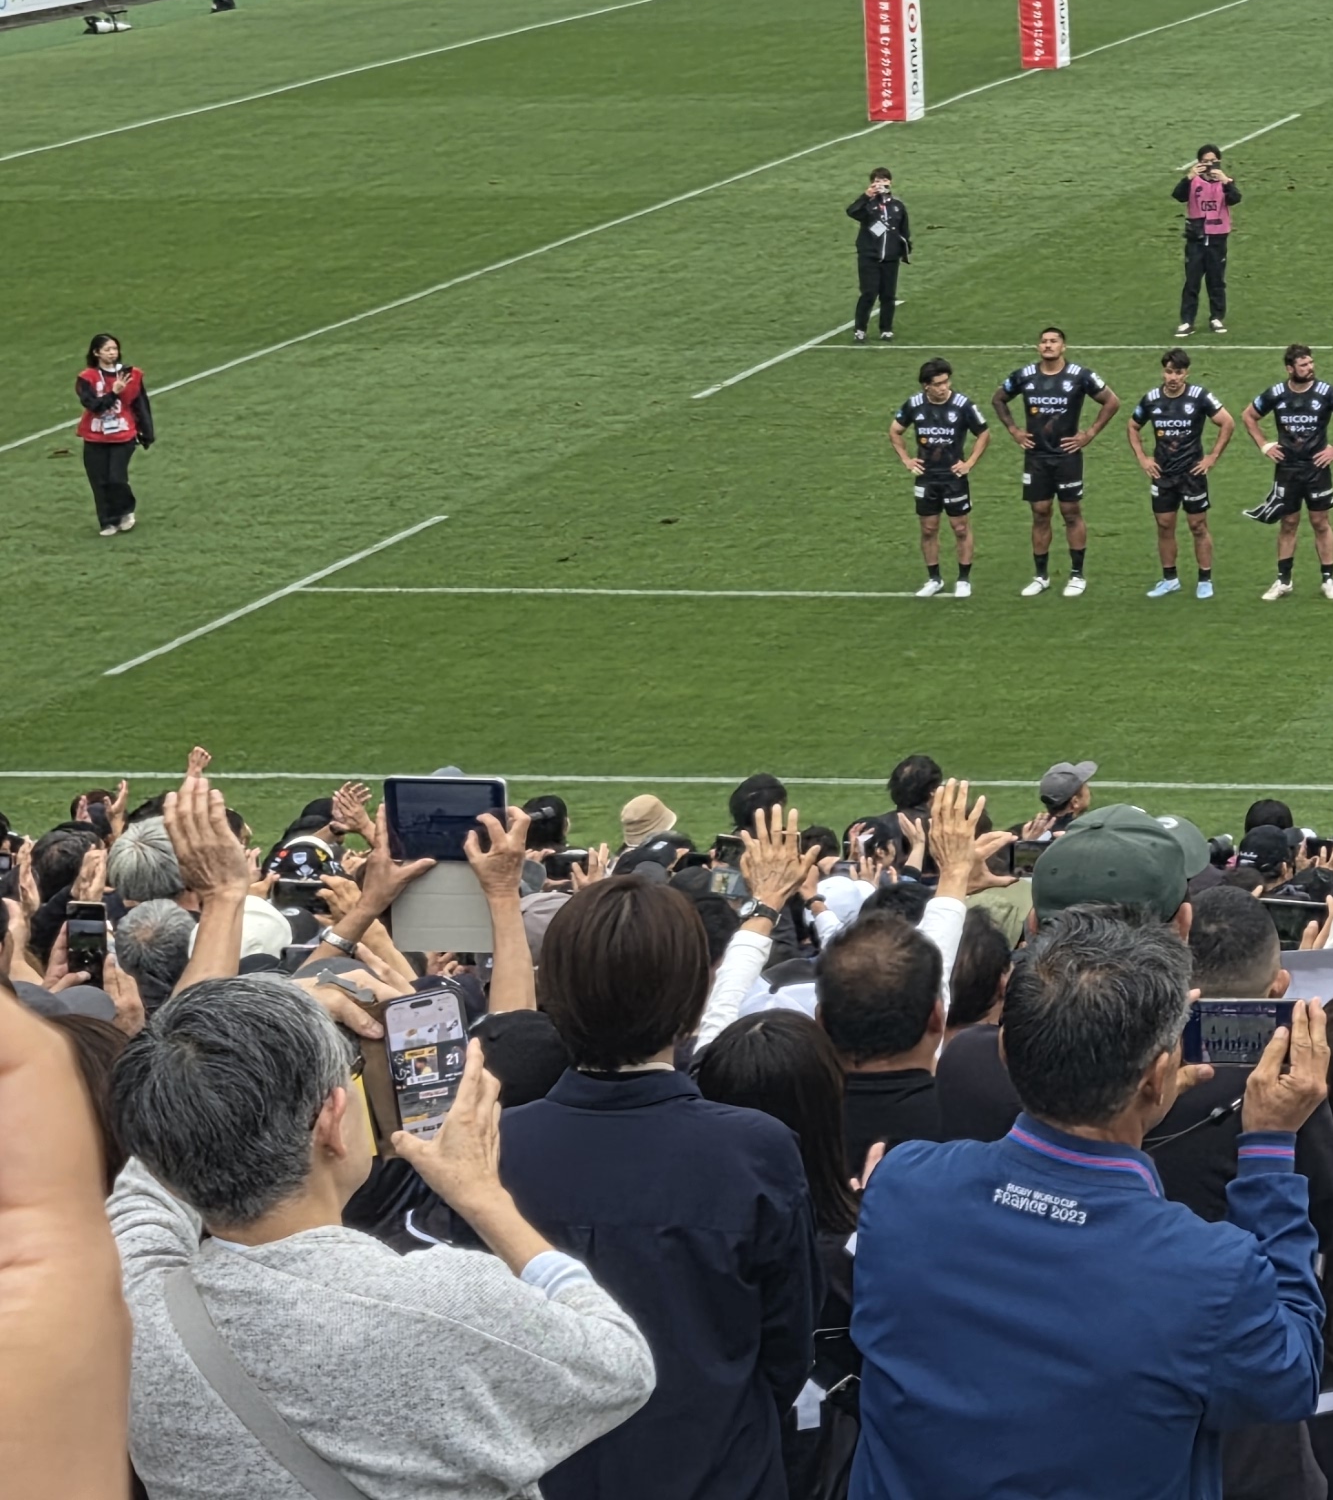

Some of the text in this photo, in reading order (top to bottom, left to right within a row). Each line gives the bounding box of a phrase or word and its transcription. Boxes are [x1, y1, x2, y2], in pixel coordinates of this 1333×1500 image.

[909, 37, 920, 97] MUFG
[1028, 396, 1068, 405] RICOH
[1155, 419, 1192, 428] RICOH
[1280, 415, 1318, 424] RICOH
[918, 427, 955, 436] RICOH
[445, 1052, 460, 1067] 21
[1006, 1182, 1079, 1209] RUGBY WORLD CUP
[1050, 1204, 1088, 1226] 2023
